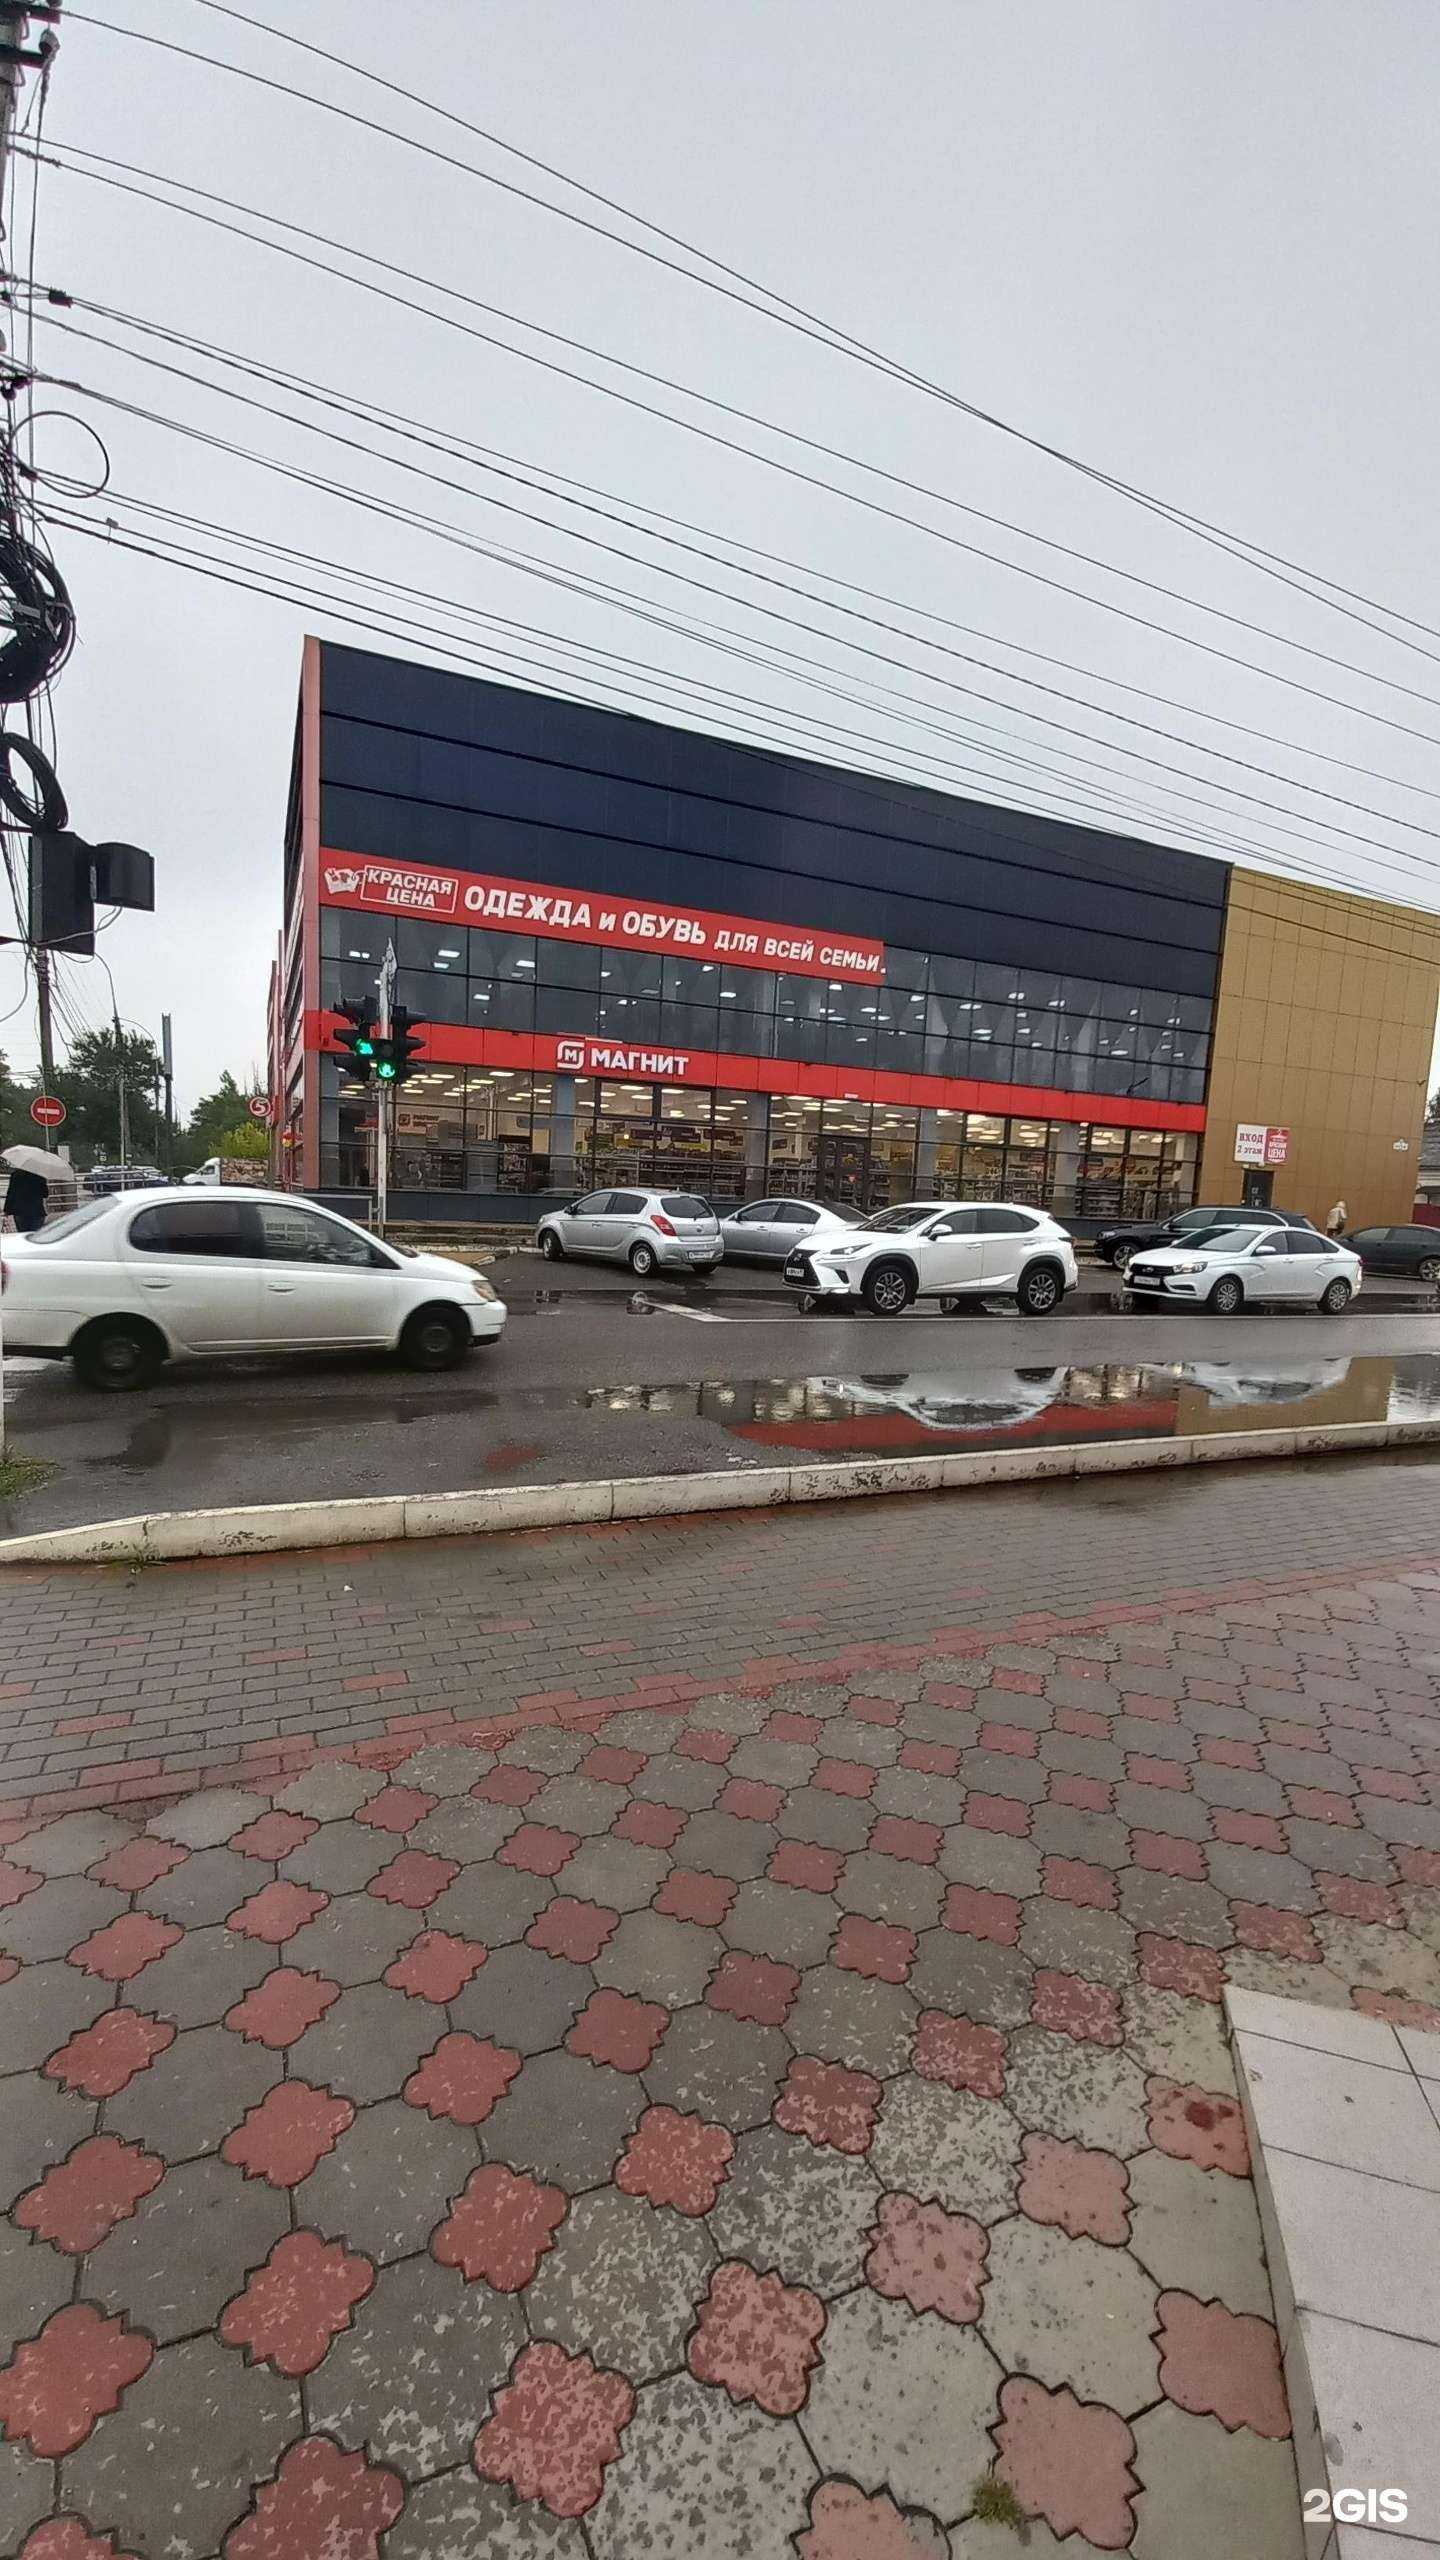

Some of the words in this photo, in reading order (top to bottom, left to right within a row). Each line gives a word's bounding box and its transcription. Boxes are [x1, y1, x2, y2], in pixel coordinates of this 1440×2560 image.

[368, 869, 453, 895] КРАСНАЯ
[385, 887, 436, 908] ЦЕНА
[464, 885, 591, 928] ОДЕЖДА
[622, 910, 707, 945] ОБУВЬ
[713, 929, 758, 953] ДЛЯ
[763, 938, 815, 962] ВСЕЙ
[819, 947, 886, 974] СЕМЬИ.
[591, 1047, 689, 1075] МАГНИТ
[1239, 1133, 1263, 1144] ВХОД
